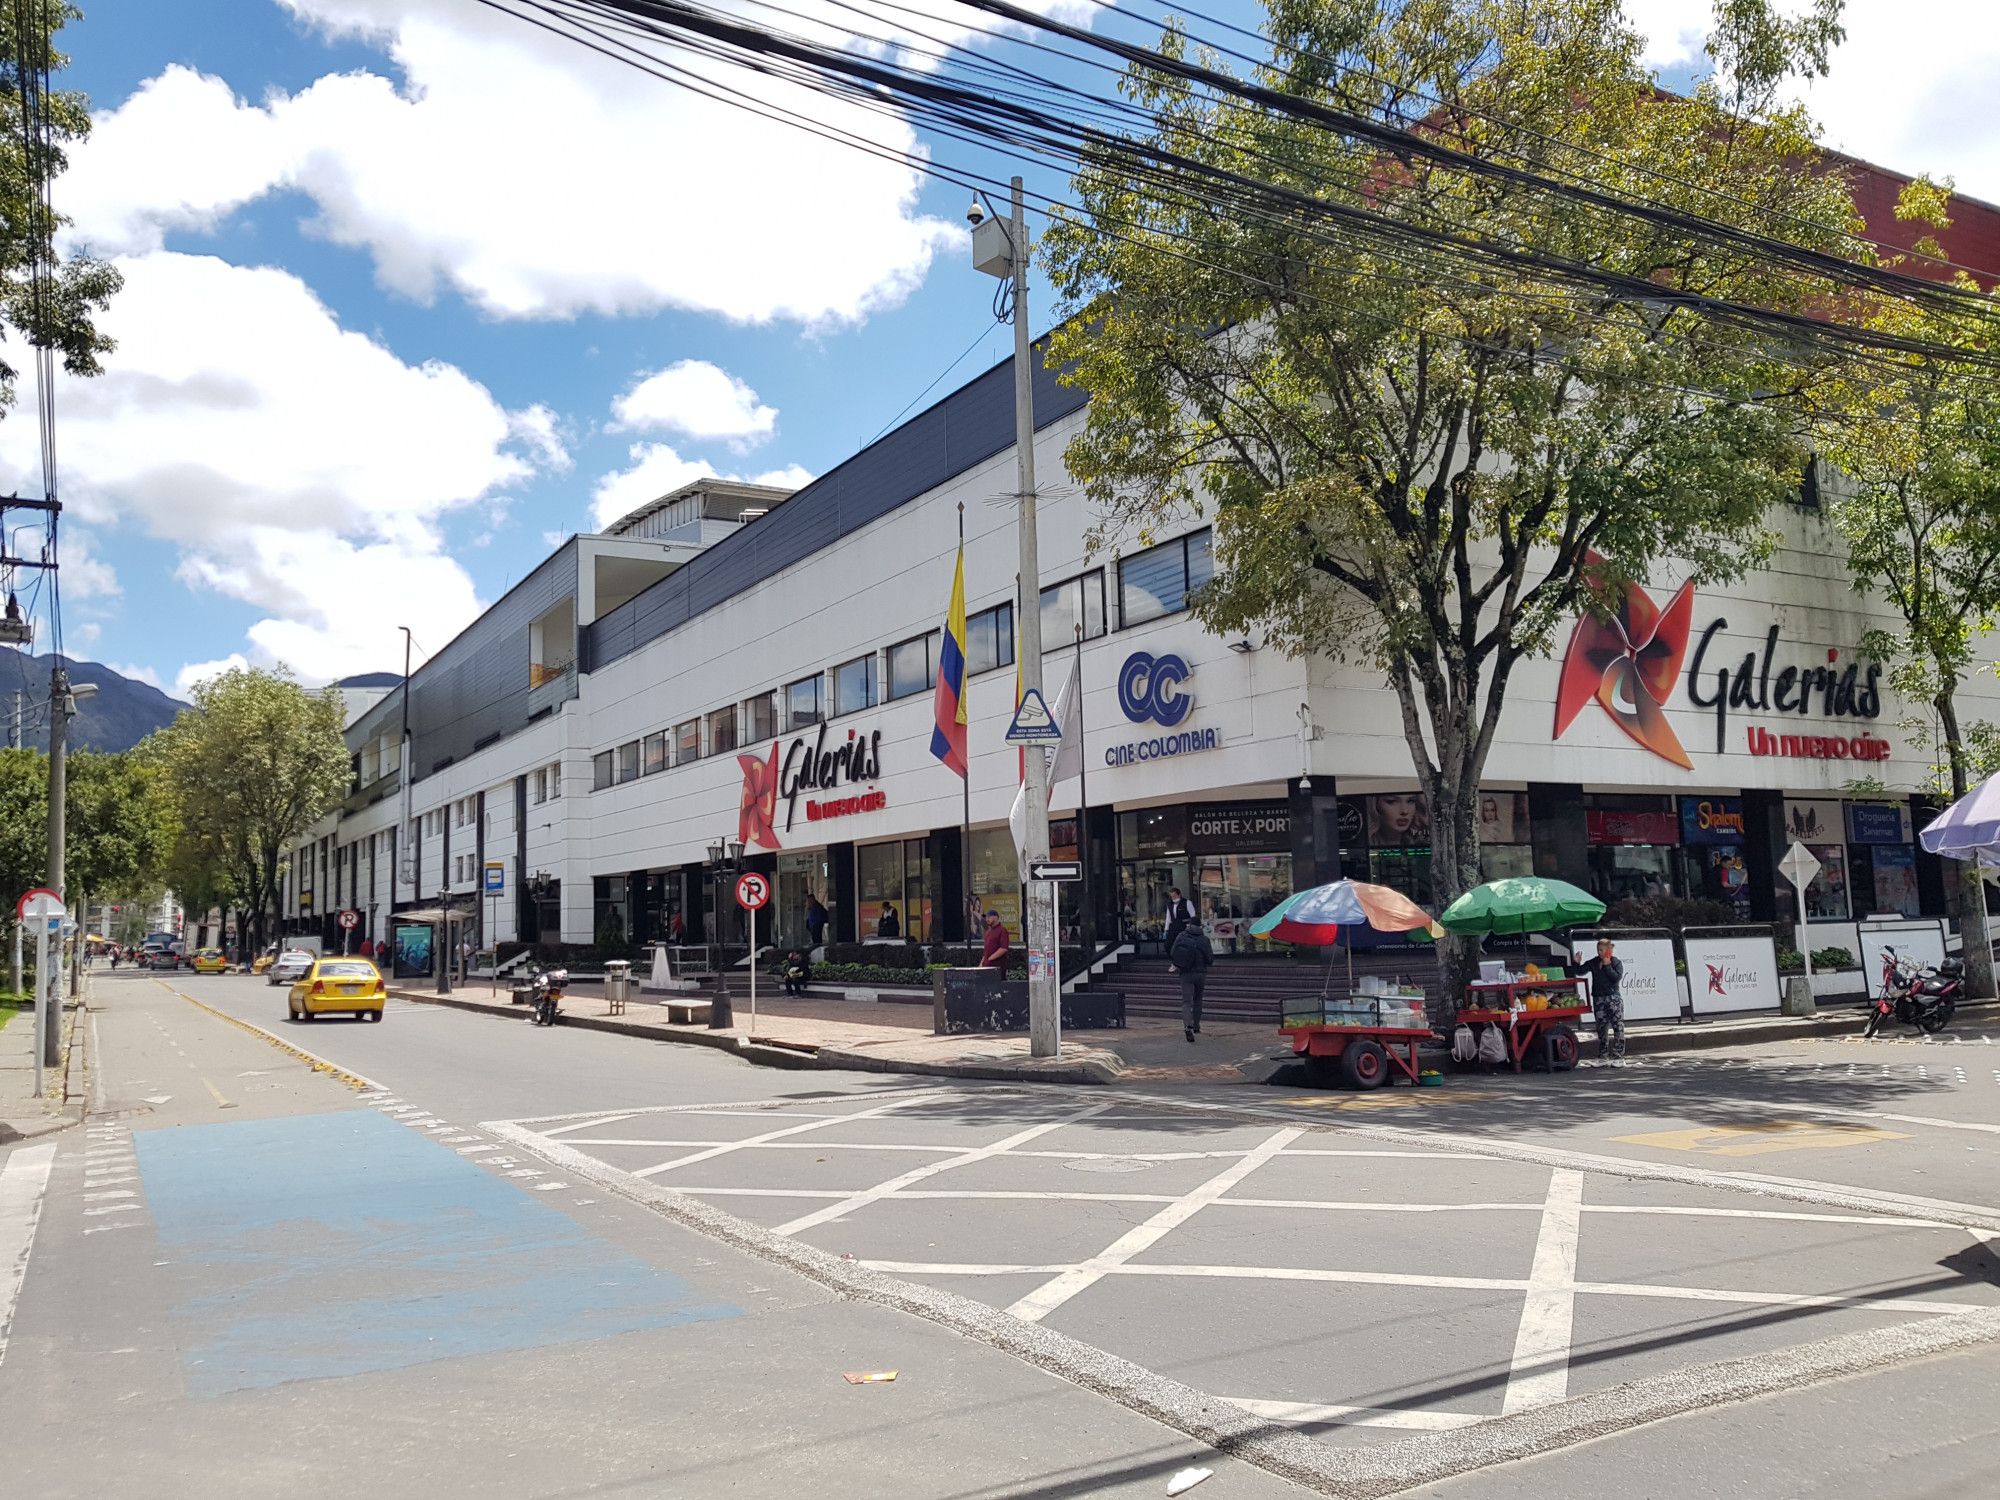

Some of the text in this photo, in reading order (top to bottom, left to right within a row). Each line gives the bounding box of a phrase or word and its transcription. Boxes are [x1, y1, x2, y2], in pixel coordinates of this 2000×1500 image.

[1105, 727, 1216, 766] CINE COLOMBIA
[1747, 727, 1891, 761] Un nuevo aire
[806, 799, 822, 821] Un
[1229, 809, 1258, 817] BELLEZA
[1191, 819, 1241, 836] CORTE
